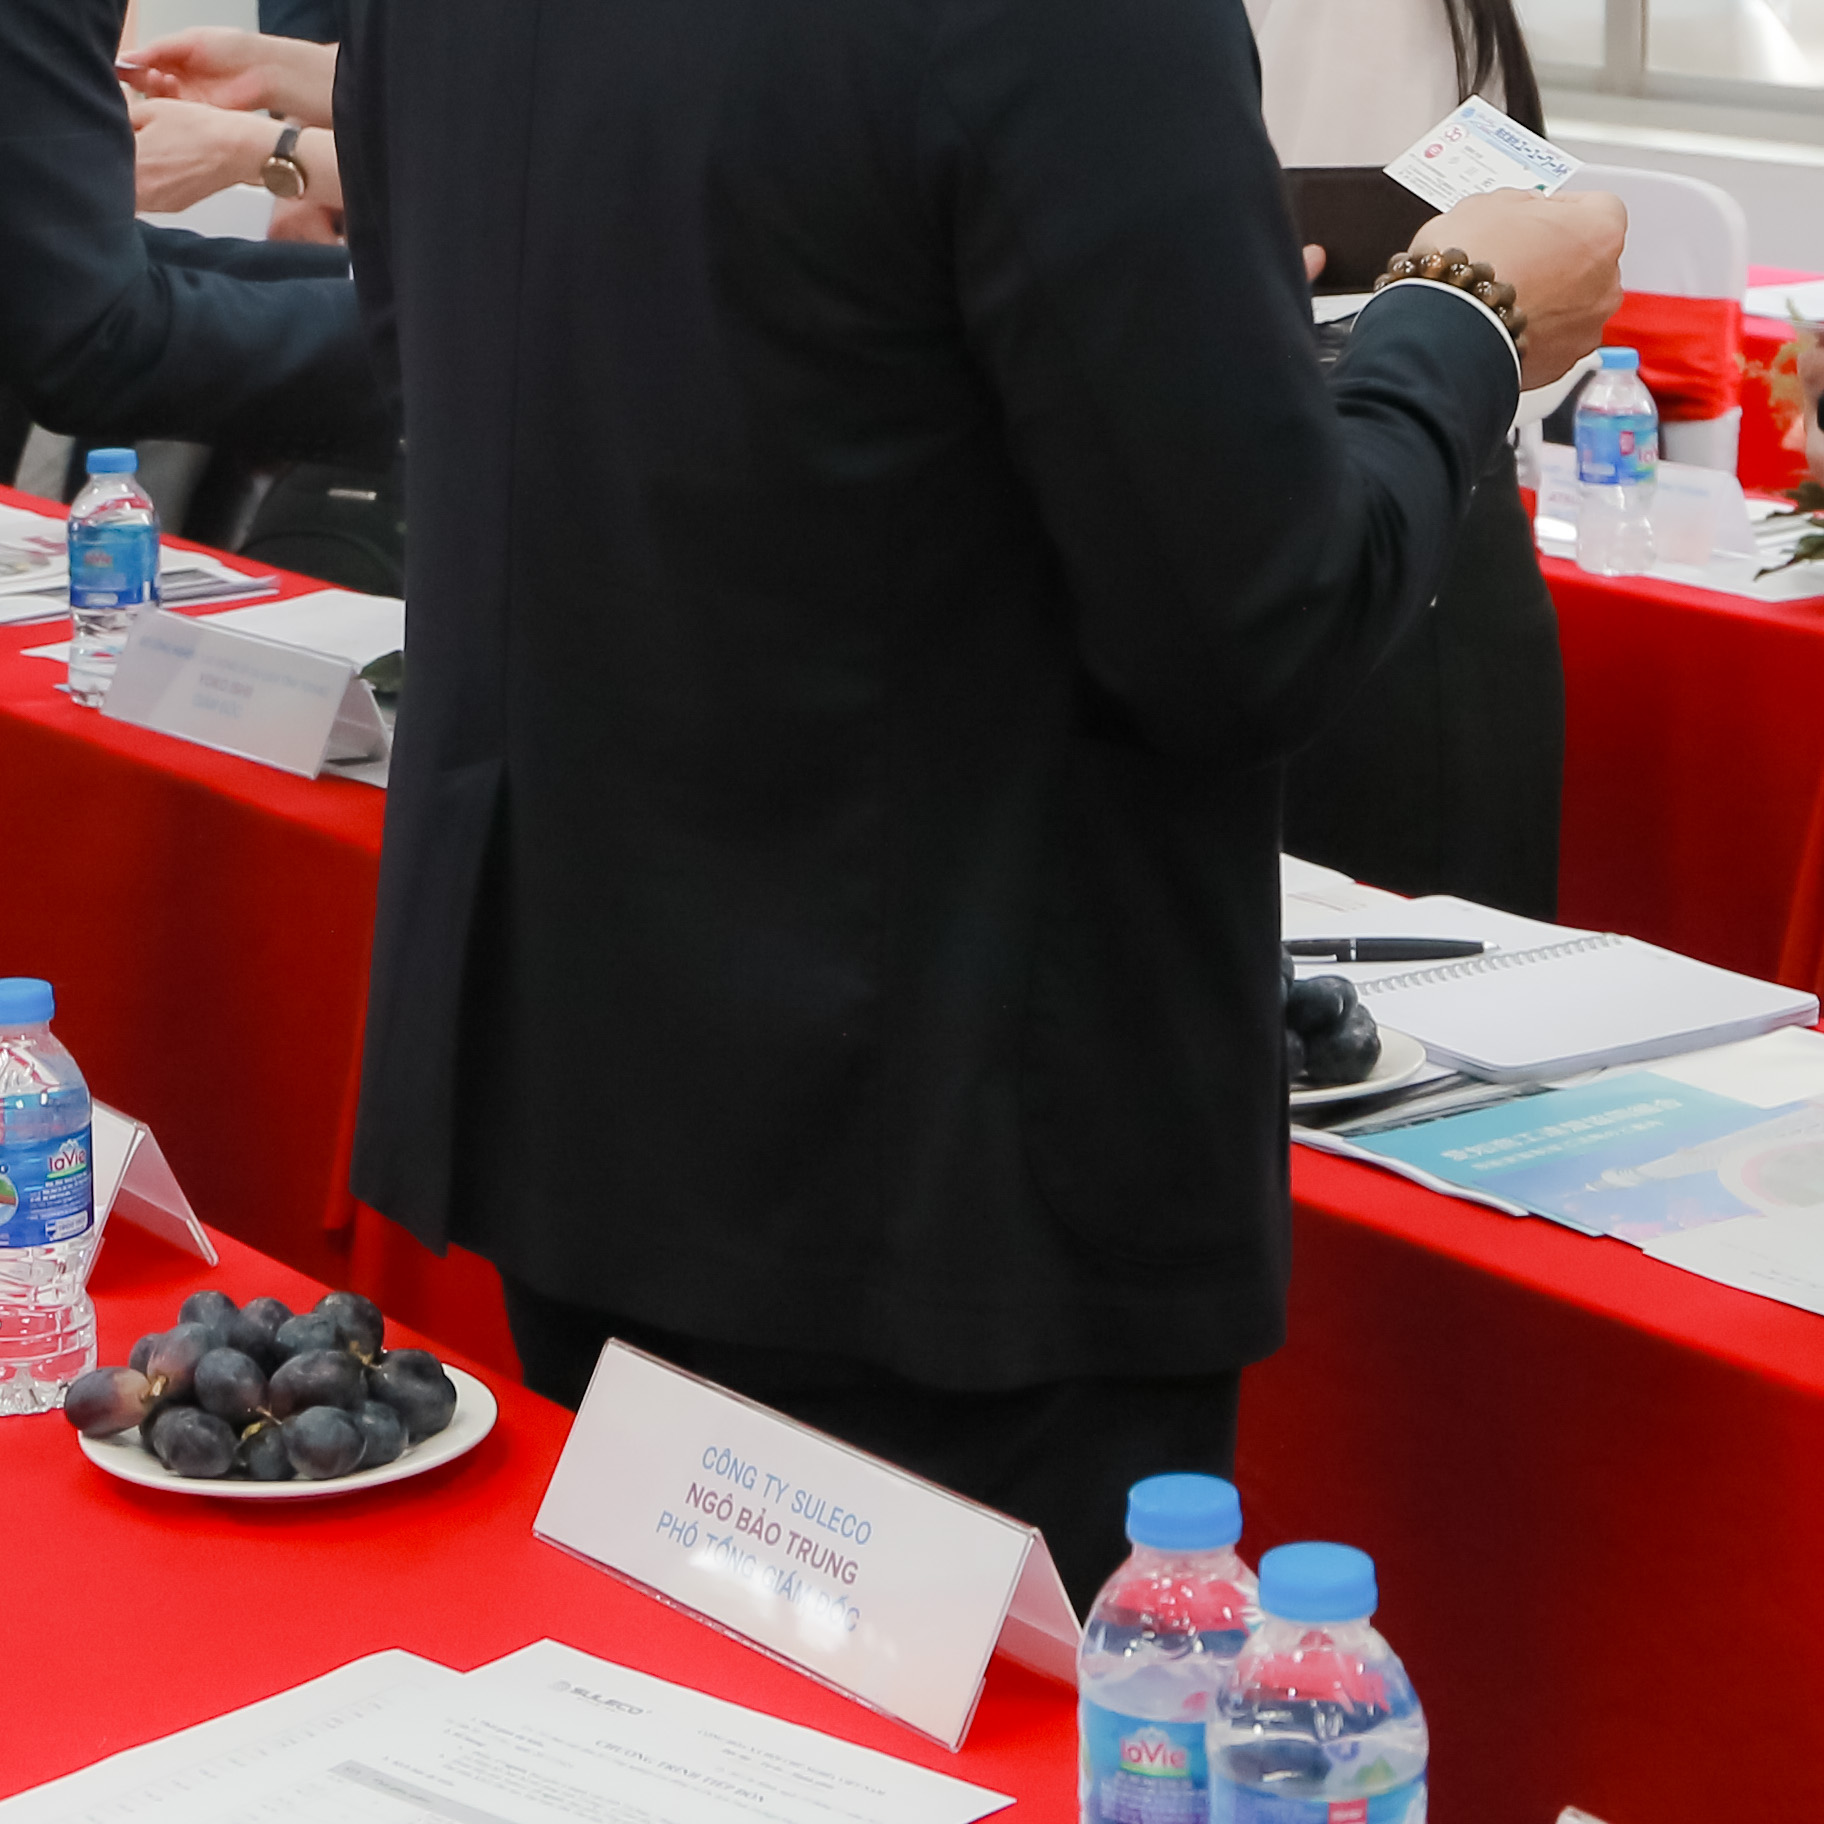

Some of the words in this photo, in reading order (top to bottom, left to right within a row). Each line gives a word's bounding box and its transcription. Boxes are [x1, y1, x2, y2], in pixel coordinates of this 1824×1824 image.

[48, 1148, 87, 1172] laVie
[701, 1446, 758, 1491] CÔNG
[762, 1472, 790, 1505] TY
[790, 1489, 873, 1546] SULECO
[655, 1510, 699, 1549] PHÓ
[684, 1481, 734, 1522] NGÔ
[734, 1507, 783, 1546] BẢO
[785, 1529, 859, 1585] TRUNG
[1119, 1736, 1188, 1770] laVie
